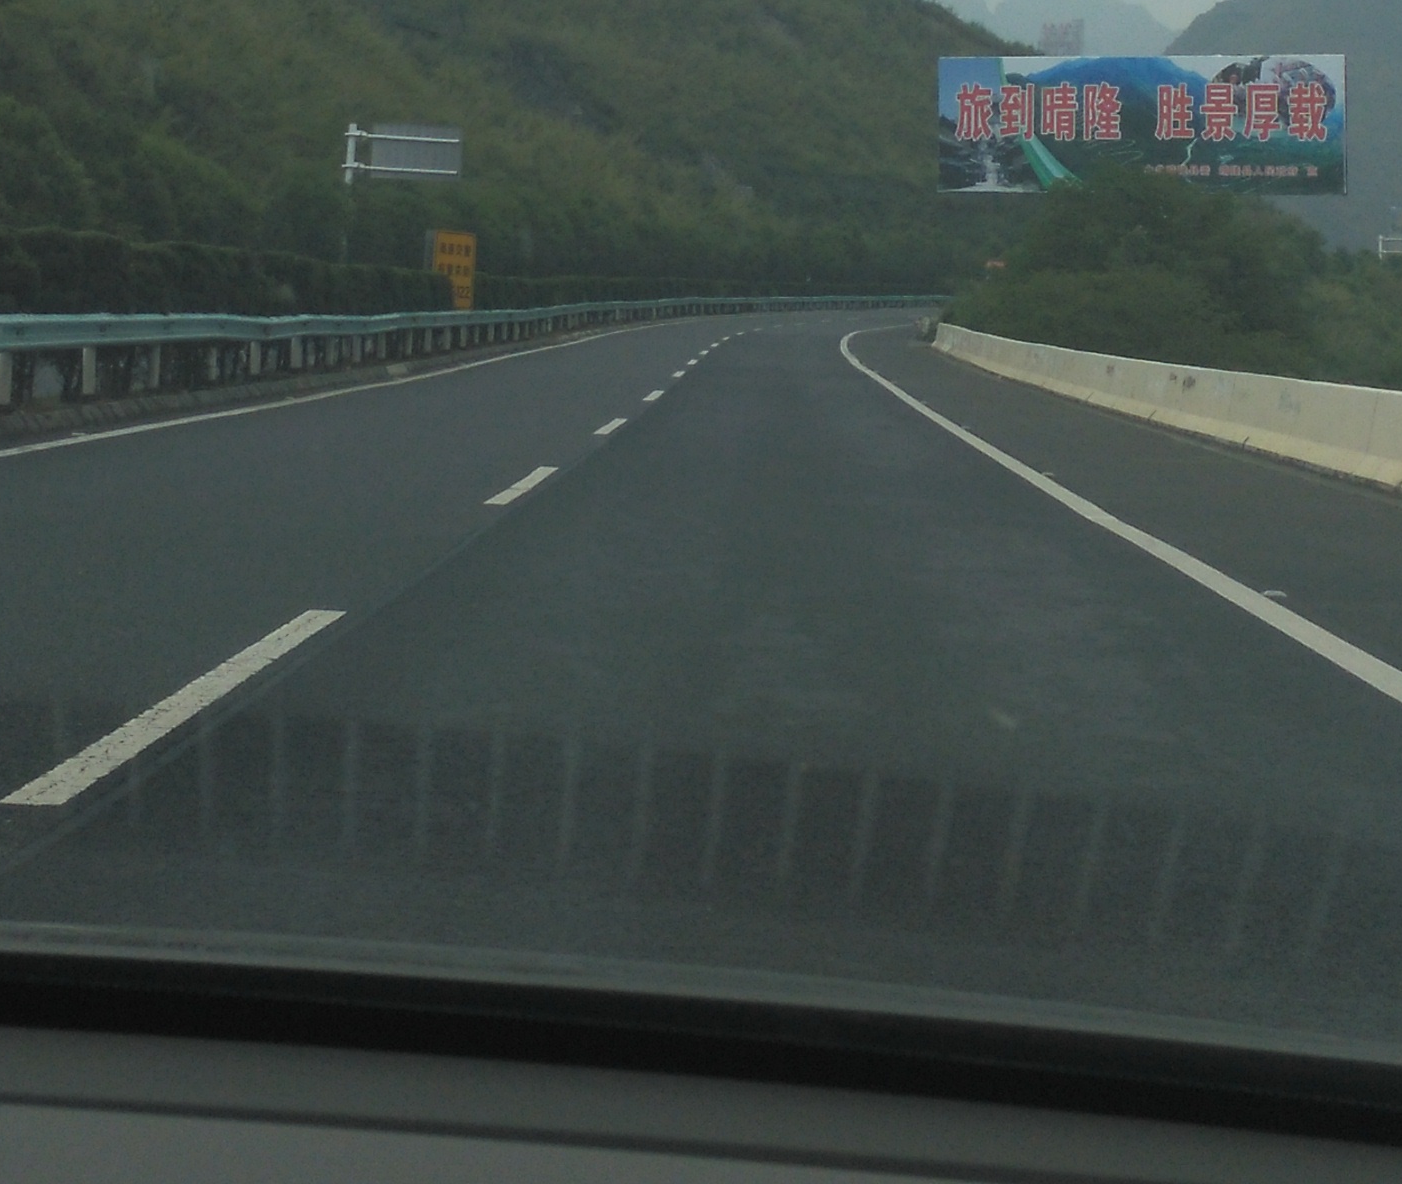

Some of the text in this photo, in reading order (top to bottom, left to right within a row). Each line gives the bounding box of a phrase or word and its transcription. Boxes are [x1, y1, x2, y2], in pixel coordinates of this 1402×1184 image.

[955, 81, 1328, 142] 旅到晴隆 胜景厚载
[456, 285, 470, 299] 122
